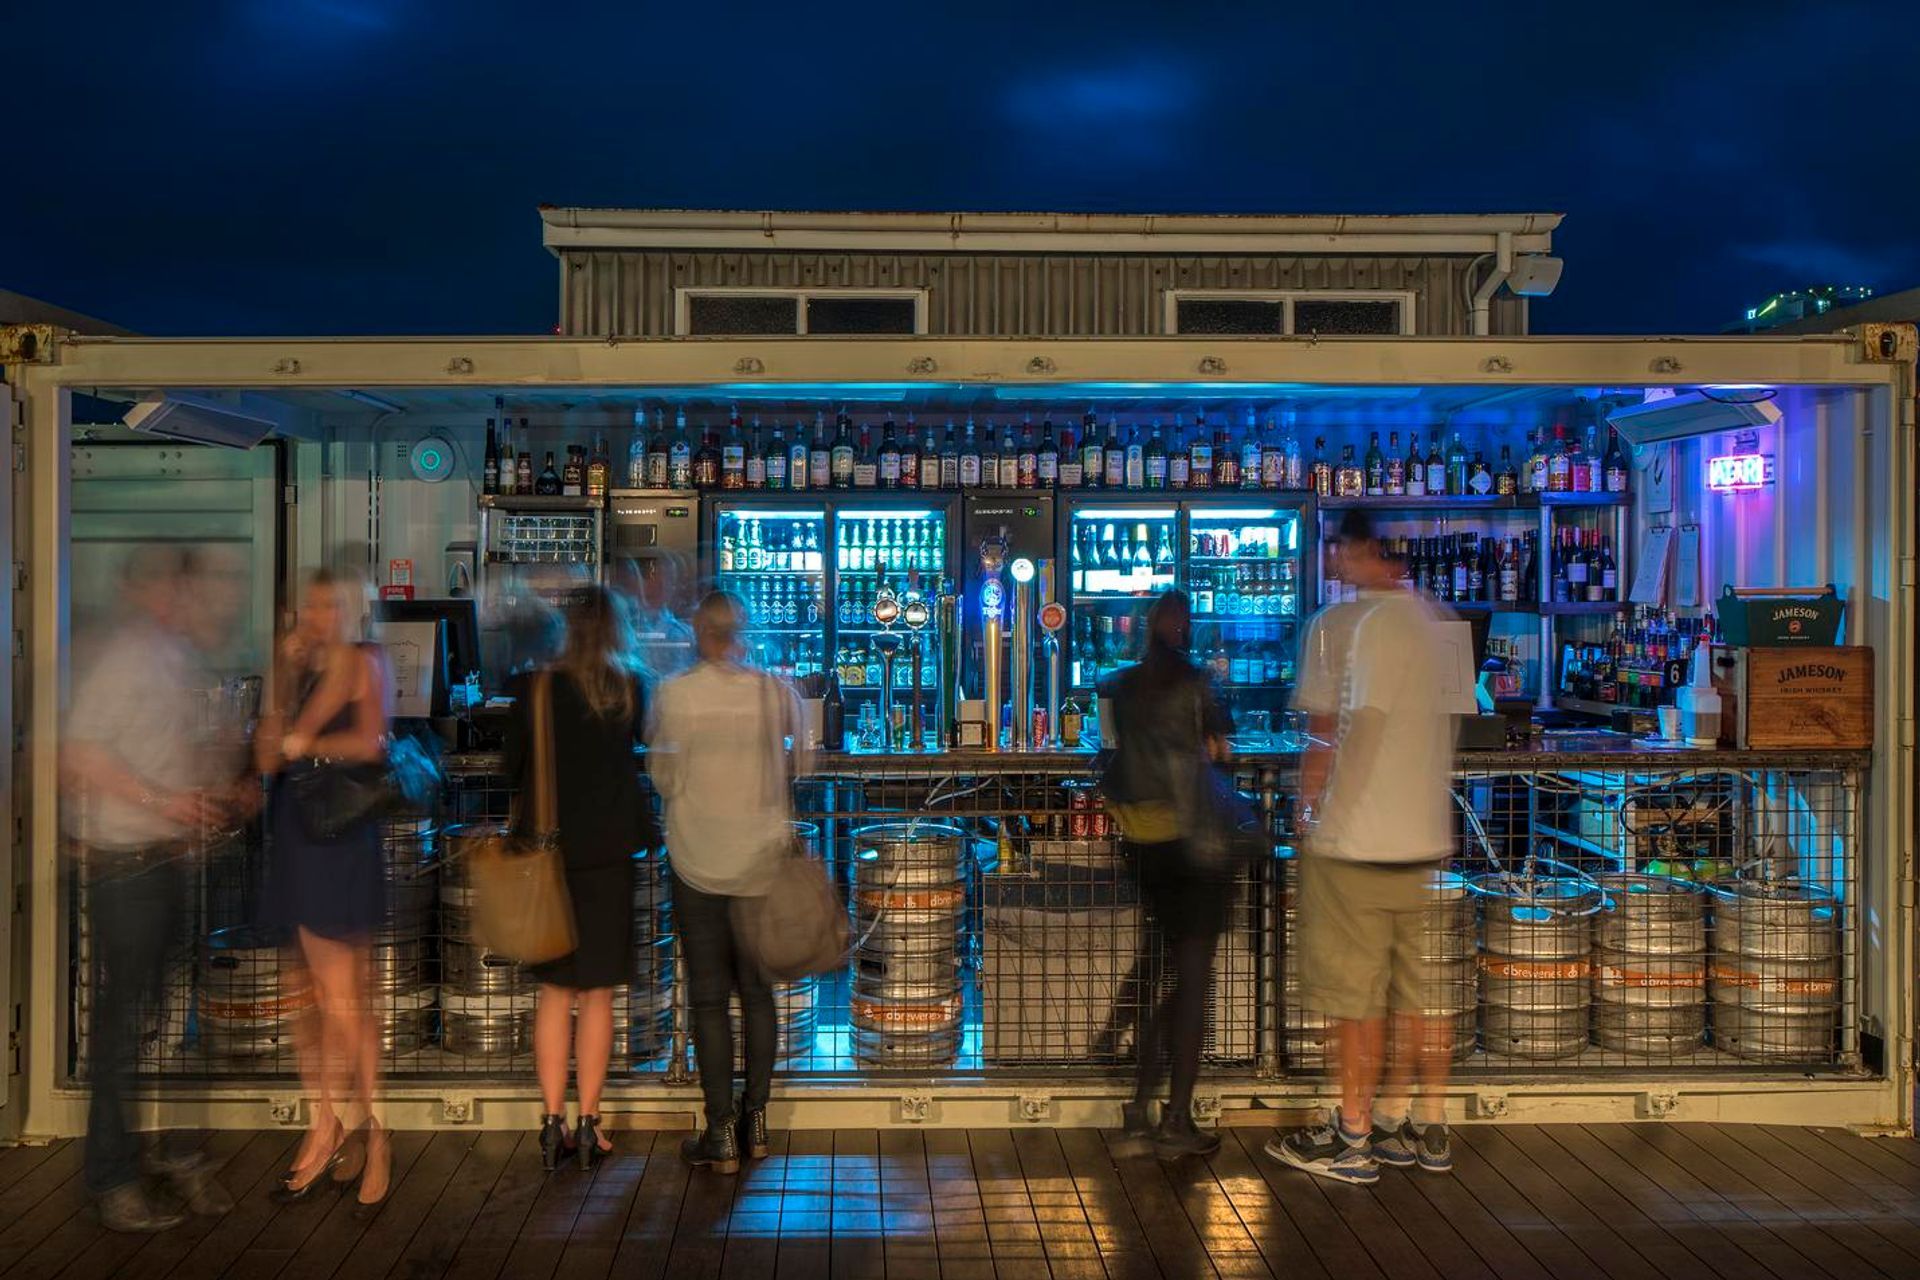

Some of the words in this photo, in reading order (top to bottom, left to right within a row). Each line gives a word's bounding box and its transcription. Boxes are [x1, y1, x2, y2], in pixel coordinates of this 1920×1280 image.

[1772, 607, 1819, 621] JAMESON
[1671, 663, 1679, 684] 6
[1778, 664, 1846, 684] JAMESON
